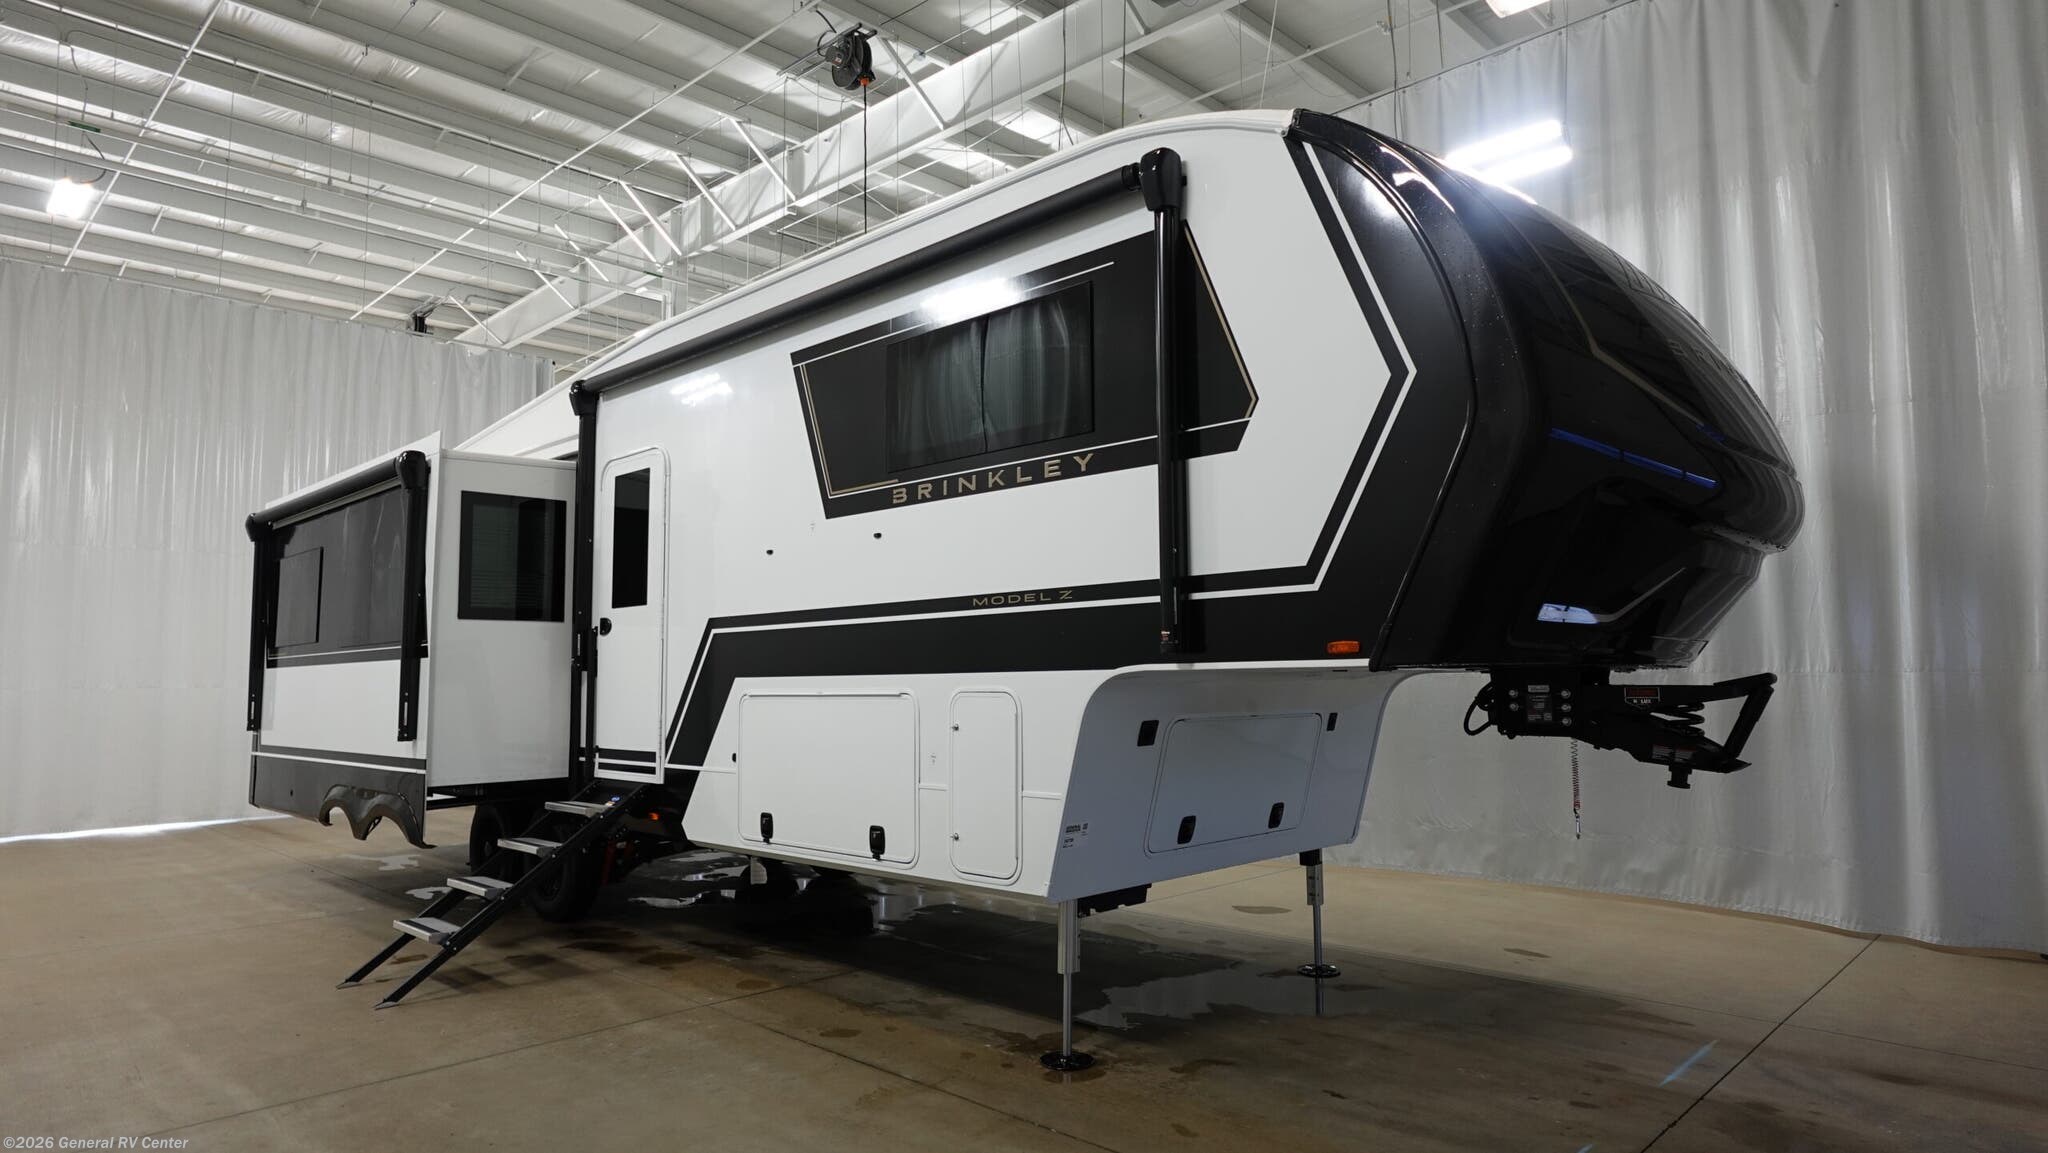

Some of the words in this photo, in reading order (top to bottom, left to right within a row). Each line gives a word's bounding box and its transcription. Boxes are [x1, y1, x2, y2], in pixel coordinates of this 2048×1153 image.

[892, 453, 1094, 504] BRINKLEY
[972, 591, 1052, 607] MODEL
[1058, 589, 1073, 601] Z
